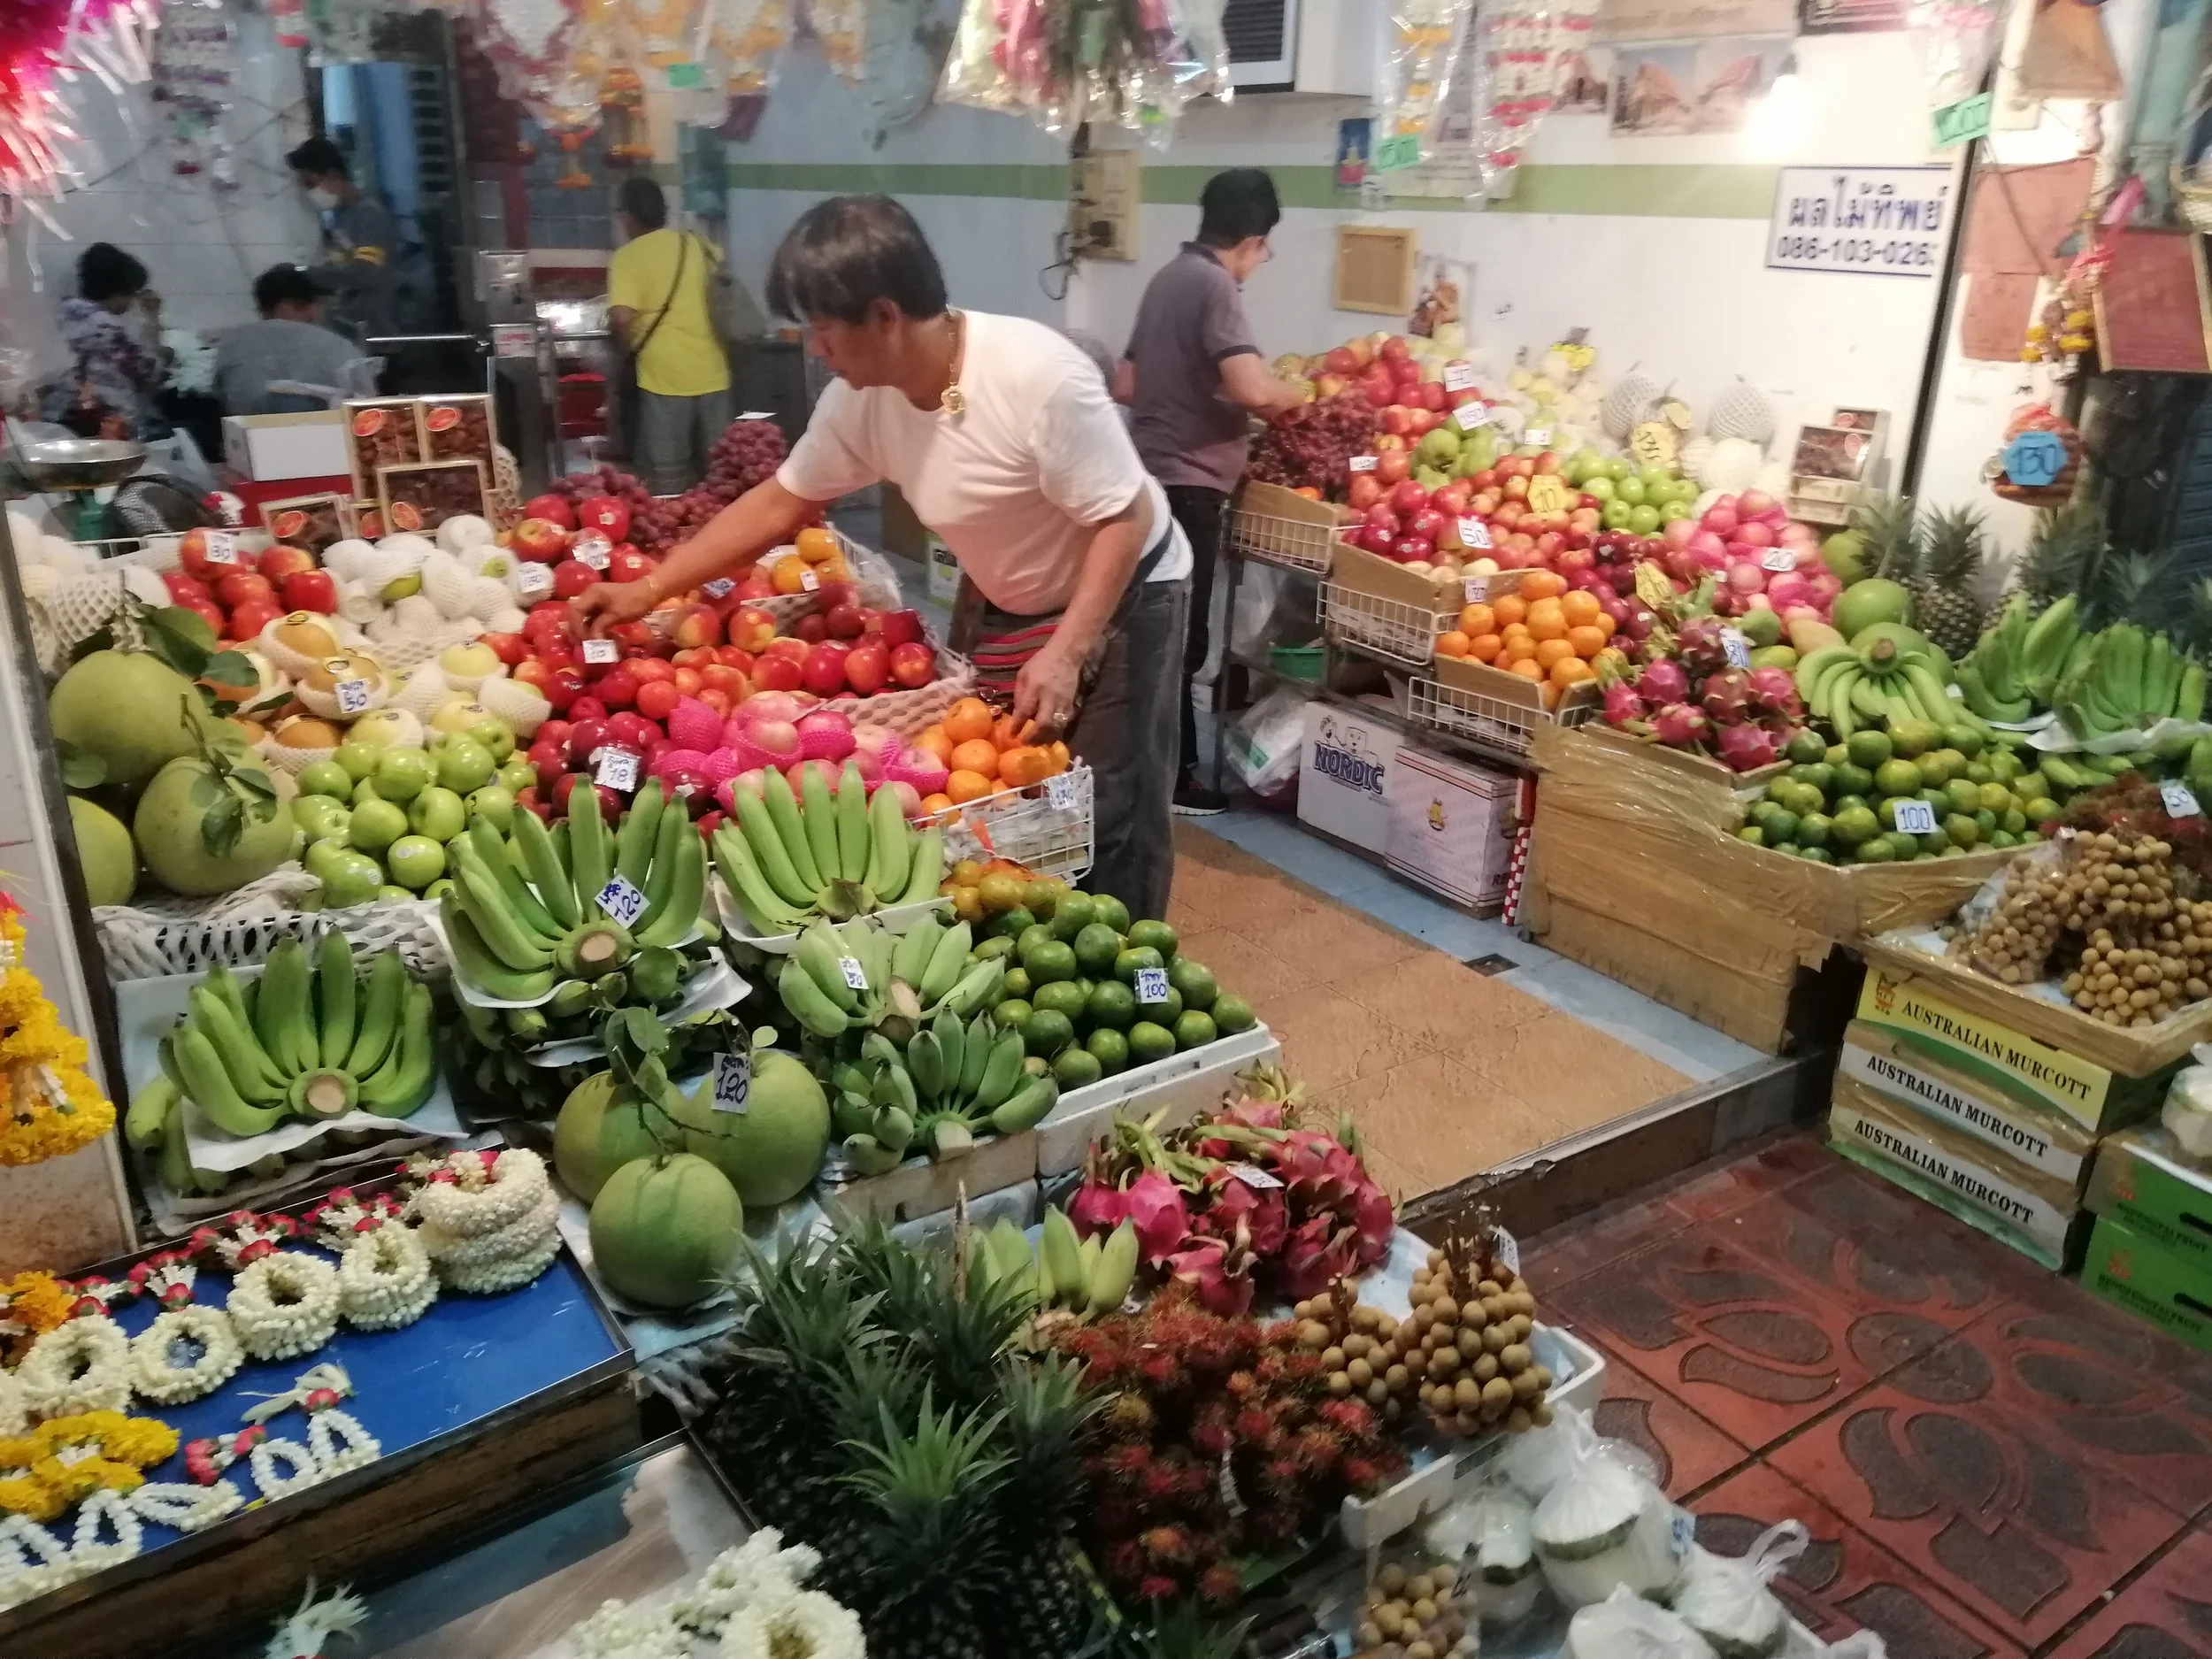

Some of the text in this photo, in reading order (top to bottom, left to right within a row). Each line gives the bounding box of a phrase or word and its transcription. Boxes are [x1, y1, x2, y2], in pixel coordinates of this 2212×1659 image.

[1312, 741, 1386, 795] NORDIC
[1900, 806, 1930, 830] 100
[1144, 982, 1167, 998] 100
[1901, 1001, 2092, 1102] AUSTRALIAN MURCOTT
[715, 1071, 748, 1104] 120
[1867, 1055, 2048, 1157] AUSTRALIAN MURCOTT
[1855, 1118, 2034, 1225] AUSTRALIAN MURCOTT
